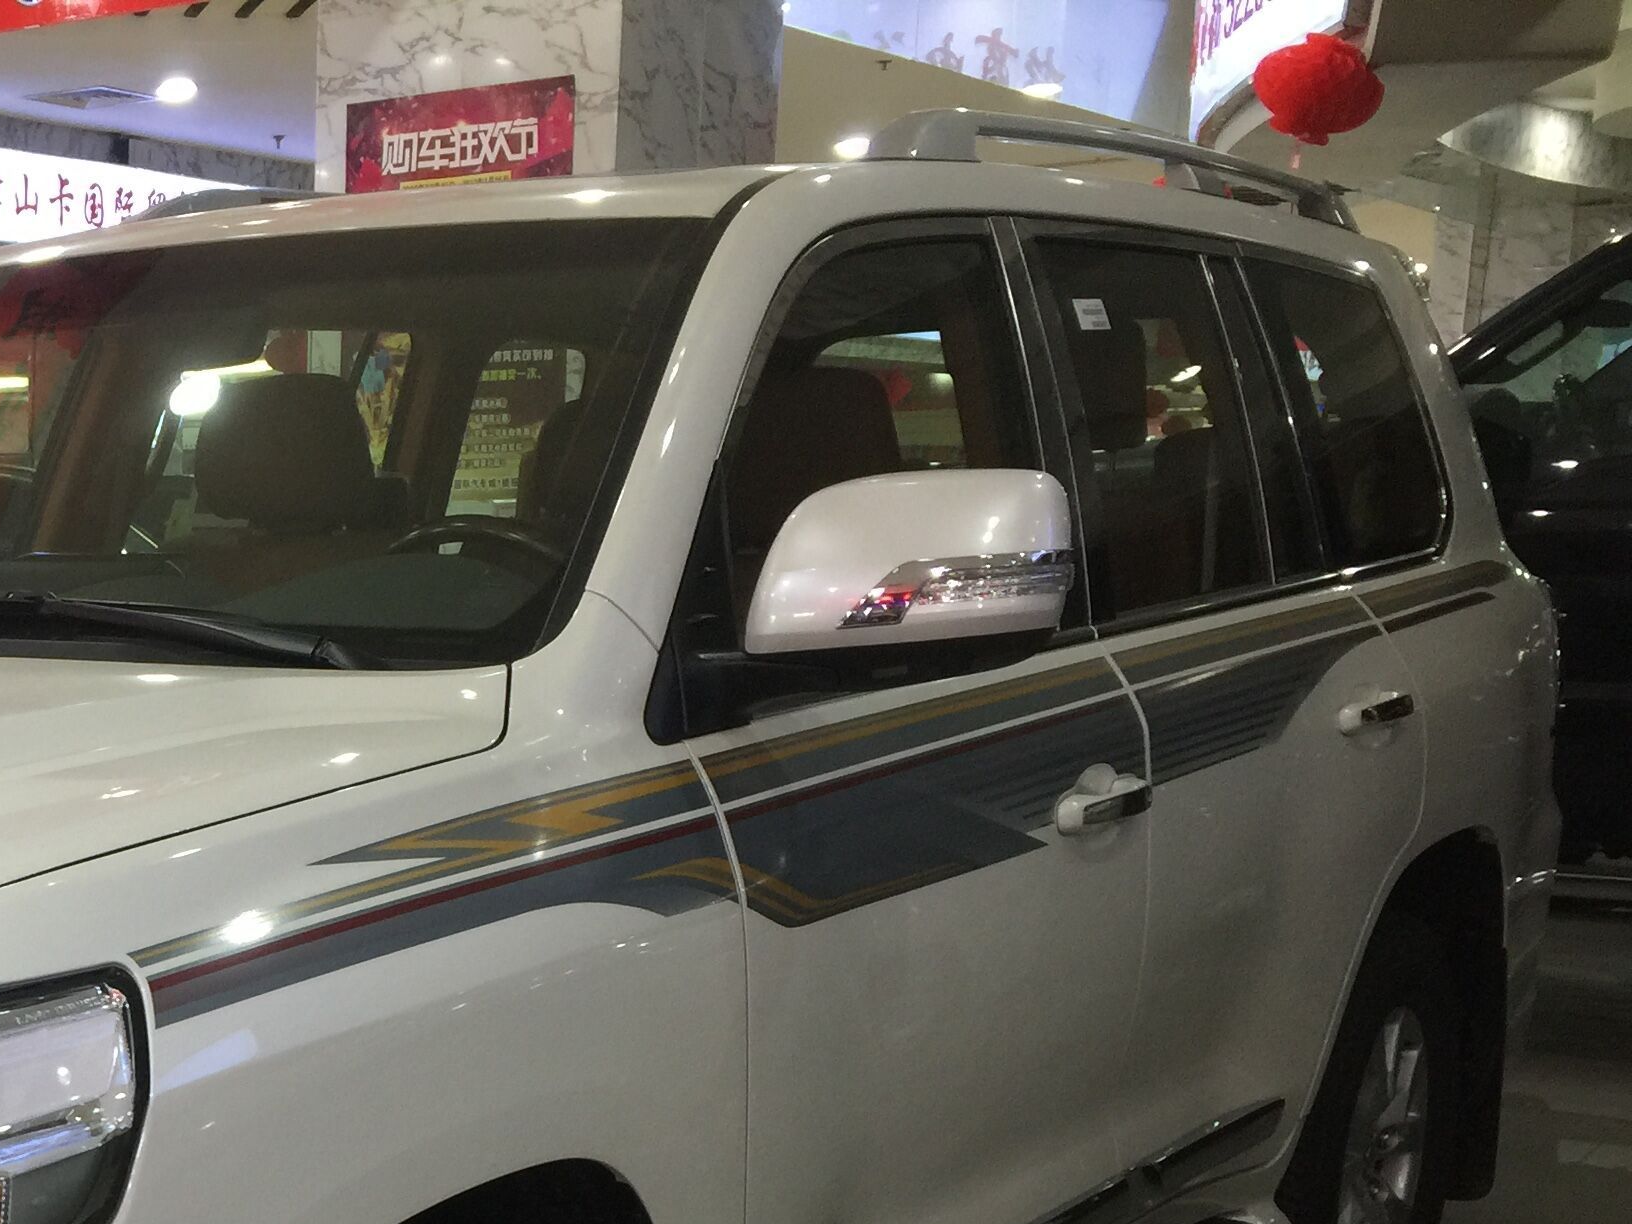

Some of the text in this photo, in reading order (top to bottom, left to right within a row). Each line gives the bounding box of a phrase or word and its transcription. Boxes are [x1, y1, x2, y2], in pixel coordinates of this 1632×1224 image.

[381, 117, 540, 176] 购车狂欢节
